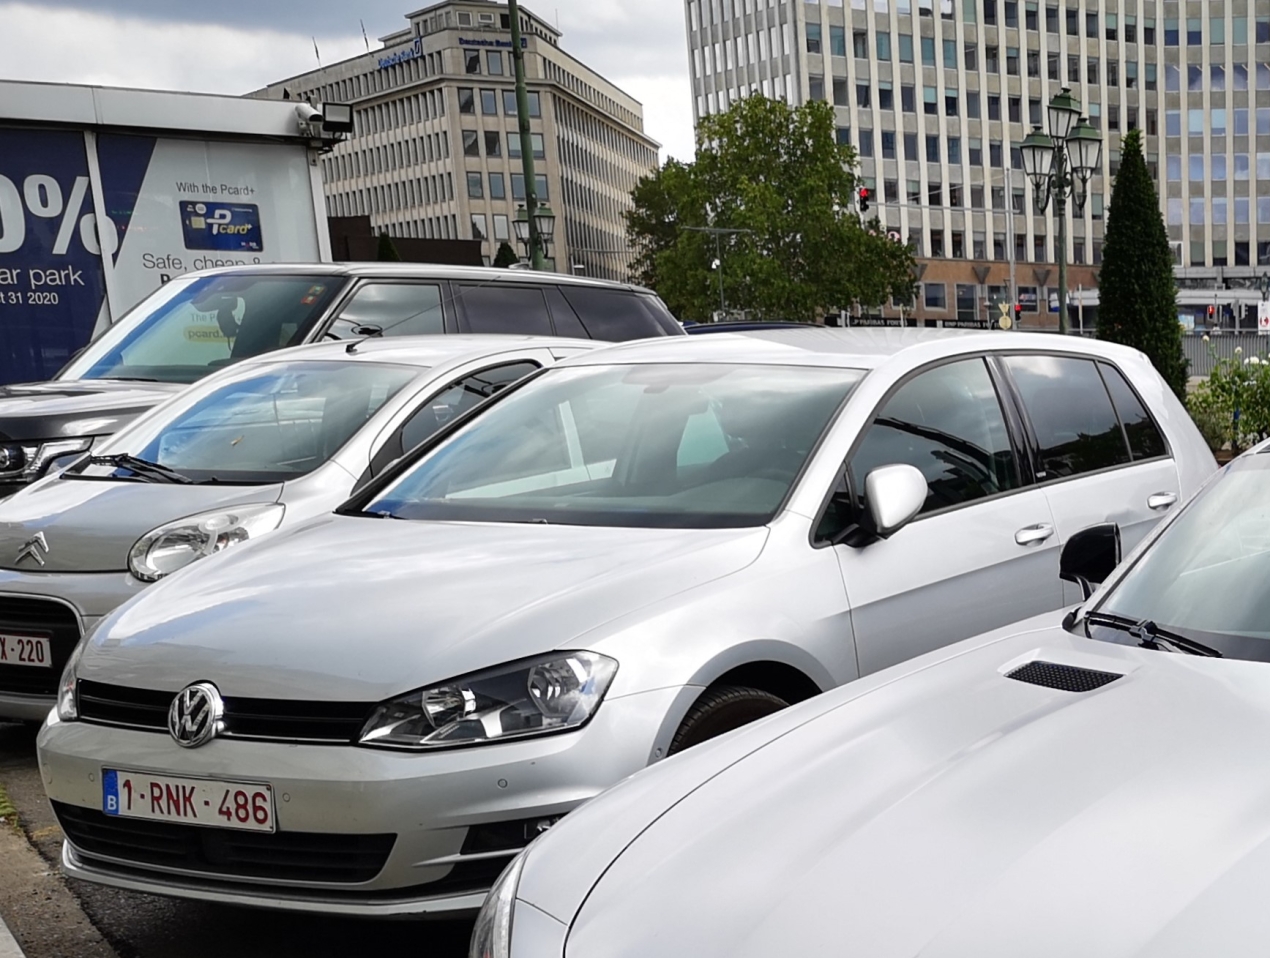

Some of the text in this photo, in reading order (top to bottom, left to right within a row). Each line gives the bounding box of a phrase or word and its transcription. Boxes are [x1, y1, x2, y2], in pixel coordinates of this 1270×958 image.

[176, 182, 255, 195] With the Pcard+
[142, 253, 188, 272] Safe,
[29, 265, 85, 290] park
[8, 292, 22, 304] 31
[27, 292, 59, 304] 2020
[107, 795, 117, 811] B
